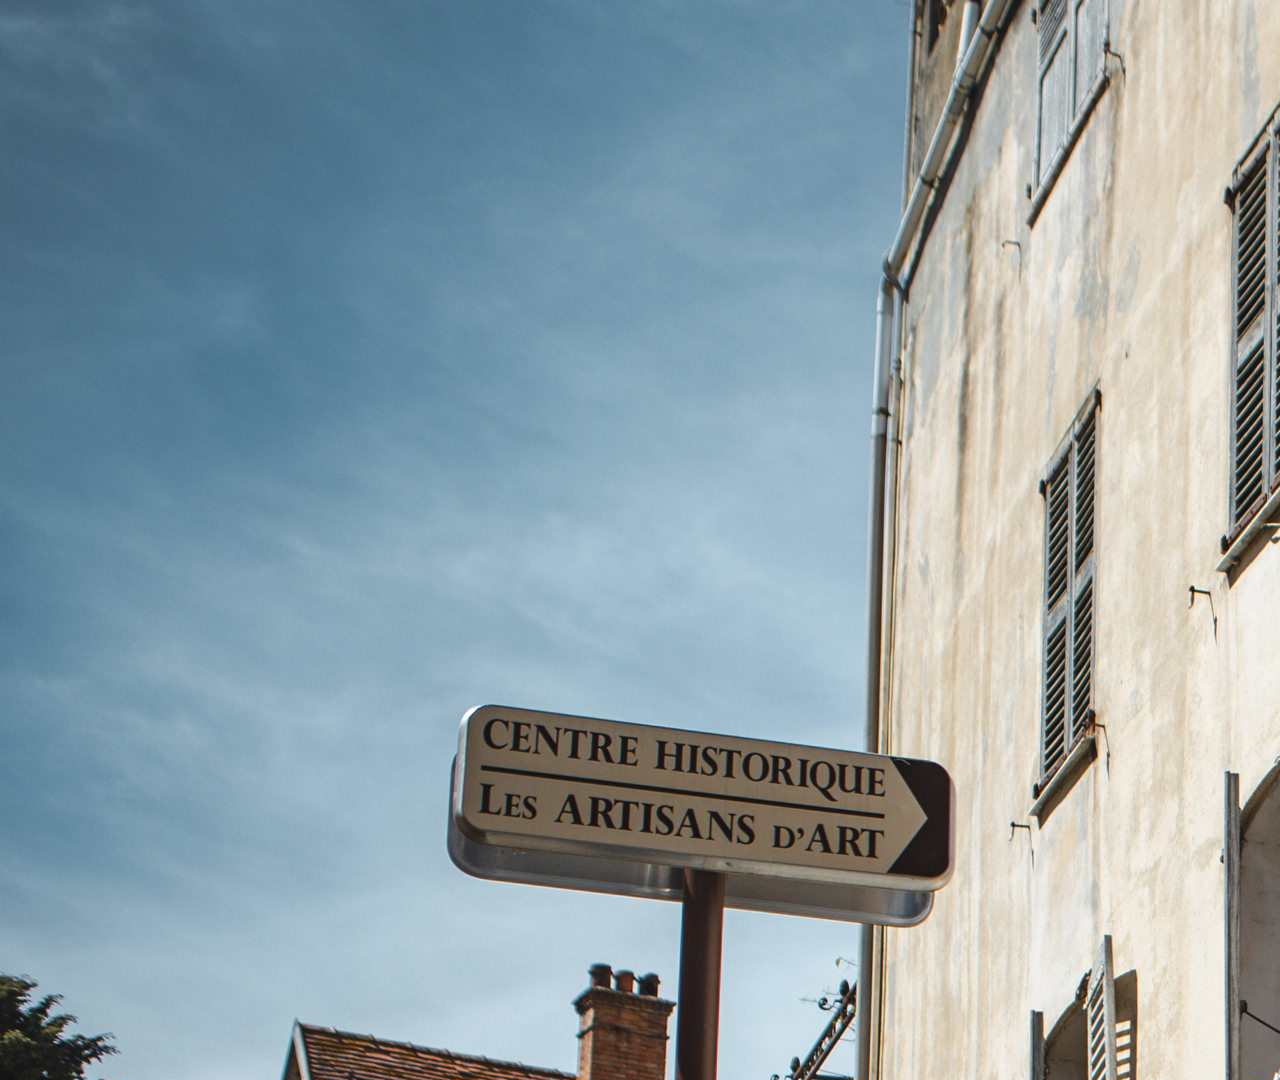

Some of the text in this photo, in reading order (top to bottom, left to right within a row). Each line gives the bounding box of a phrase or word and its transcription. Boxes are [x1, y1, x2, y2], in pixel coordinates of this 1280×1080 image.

[482, 717, 886, 802] CENTRE HISTORIQUE
[477, 782, 886, 860] LES ARTISANS D'ART
